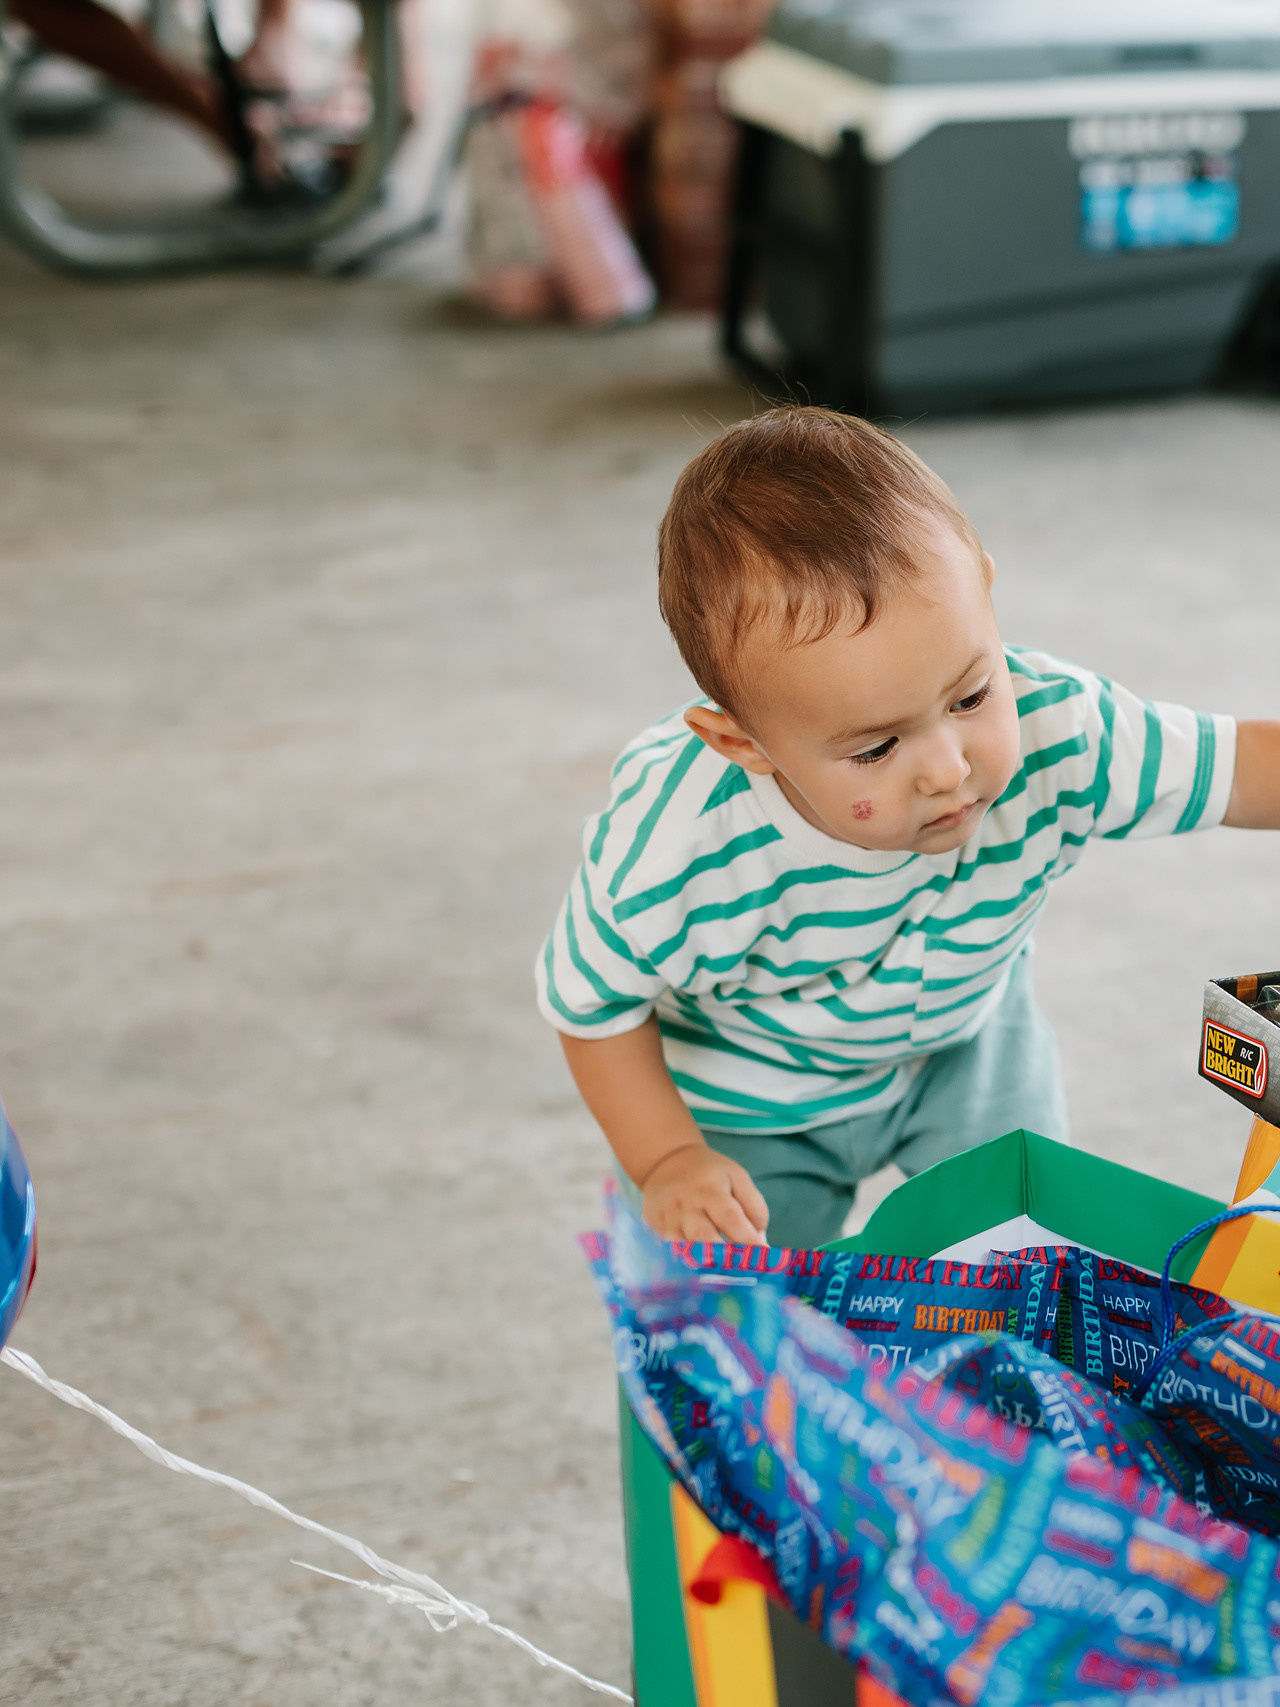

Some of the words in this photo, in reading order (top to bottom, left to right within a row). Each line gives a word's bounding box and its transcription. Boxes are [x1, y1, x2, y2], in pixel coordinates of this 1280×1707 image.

[1207, 1027, 1236, 1057] NEW
[1239, 1046, 1254, 1062] R/C
[1206, 1051, 1255, 1089] BRIGHT
[857, 1253, 1026, 1291] BIRTHDAY
[849, 1294, 905, 1315] HAPPY
[912, 1303, 1006, 1334] BIRTHDAY
[1103, 1294, 1151, 1316] HAPPY
